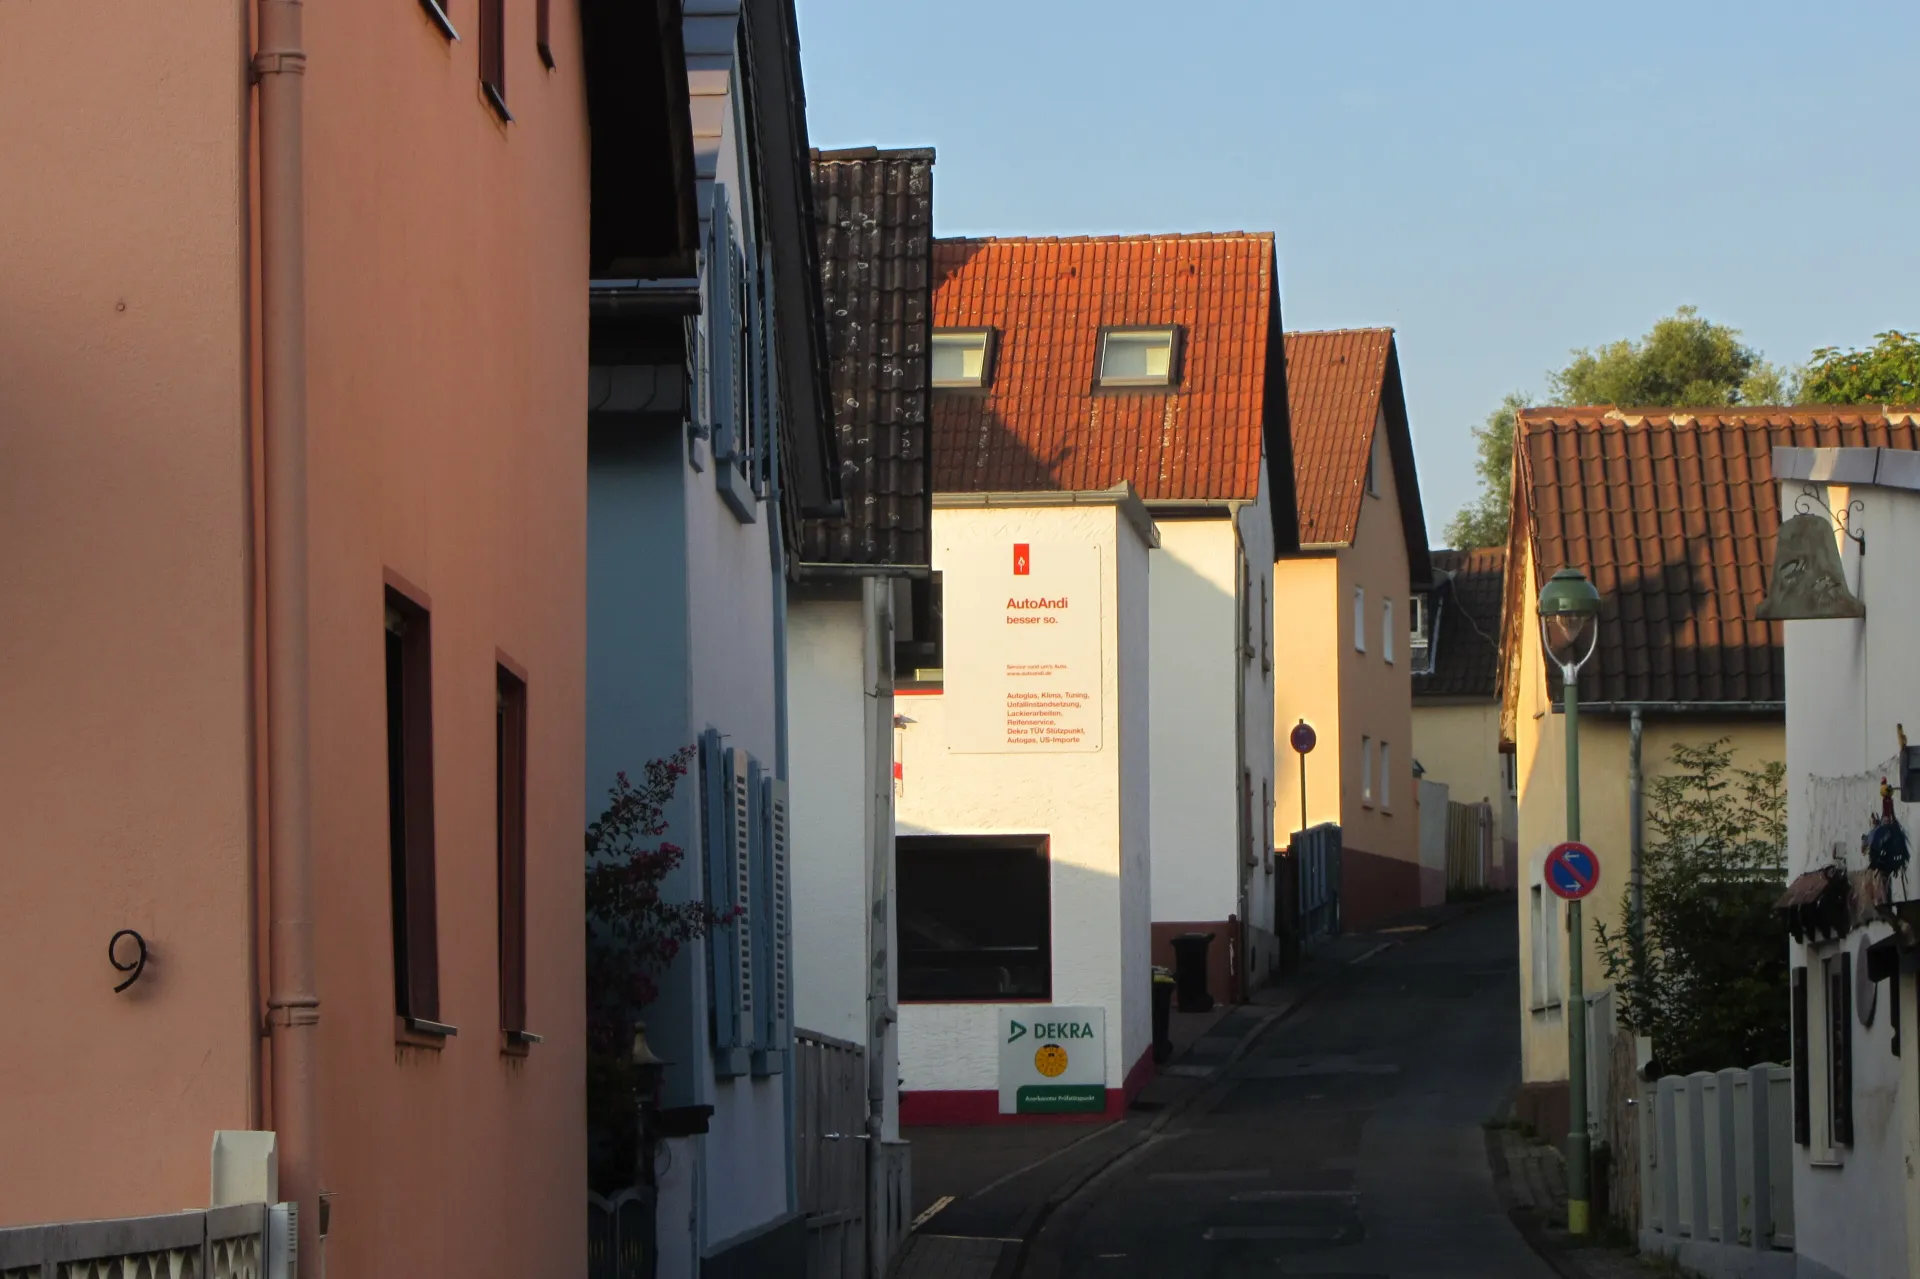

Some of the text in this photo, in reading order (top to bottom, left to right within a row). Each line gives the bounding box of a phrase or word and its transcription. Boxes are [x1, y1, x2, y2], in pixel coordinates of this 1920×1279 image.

[1006, 597, 1069, 609] AutoAndi
[1006, 615, 1059, 624] besser so.
[1006, 692, 1040, 700] Autoglas,
[1065, 691, 1090, 699] Tuning,
[1046, 727, 1086, 735] Stützpunkt,
[1007, 736, 1081, 744] Autogas, US-Importe
[109, 929, 147, 994] 9
[1034, 1022, 1094, 1039] DEKRA
